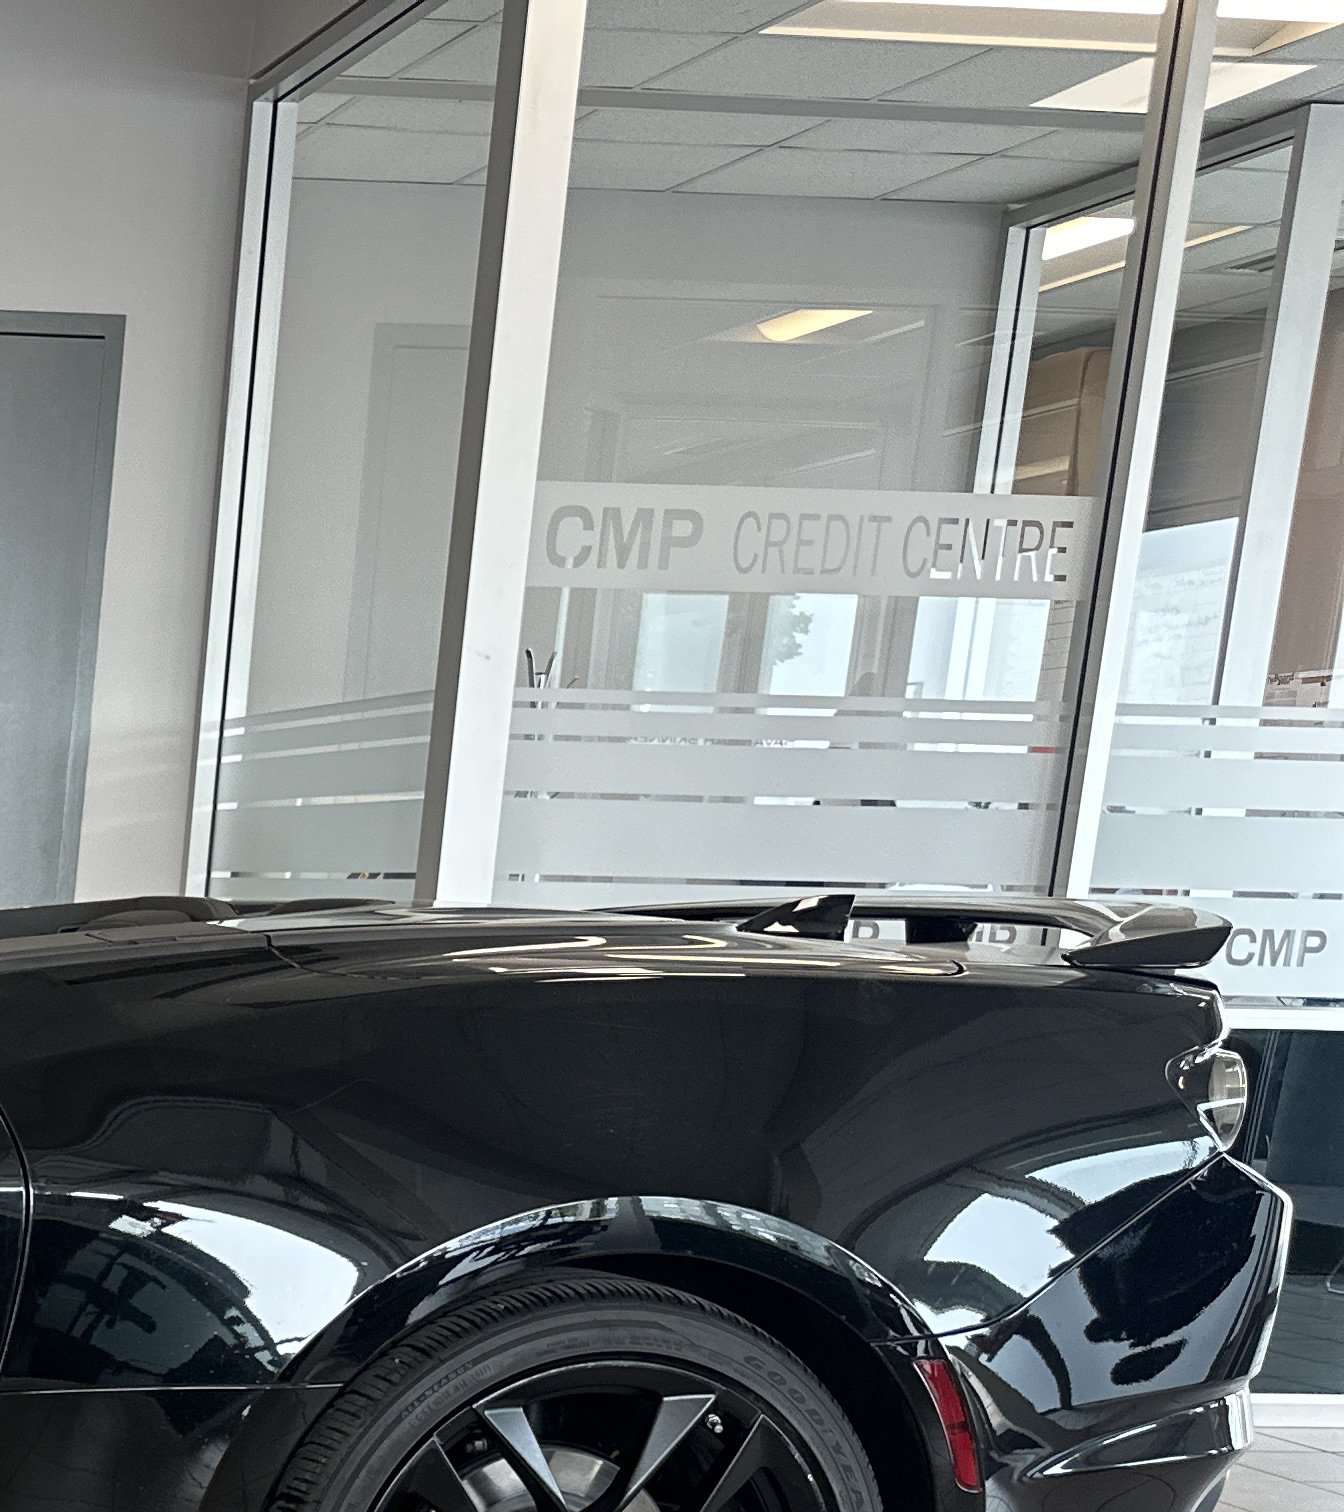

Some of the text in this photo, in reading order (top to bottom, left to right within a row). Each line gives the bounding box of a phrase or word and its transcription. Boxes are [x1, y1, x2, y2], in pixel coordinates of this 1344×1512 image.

[544, 503, 1075, 584] CMP CREDIT CENTRE
[1225, 925, 1328, 968] CMP
